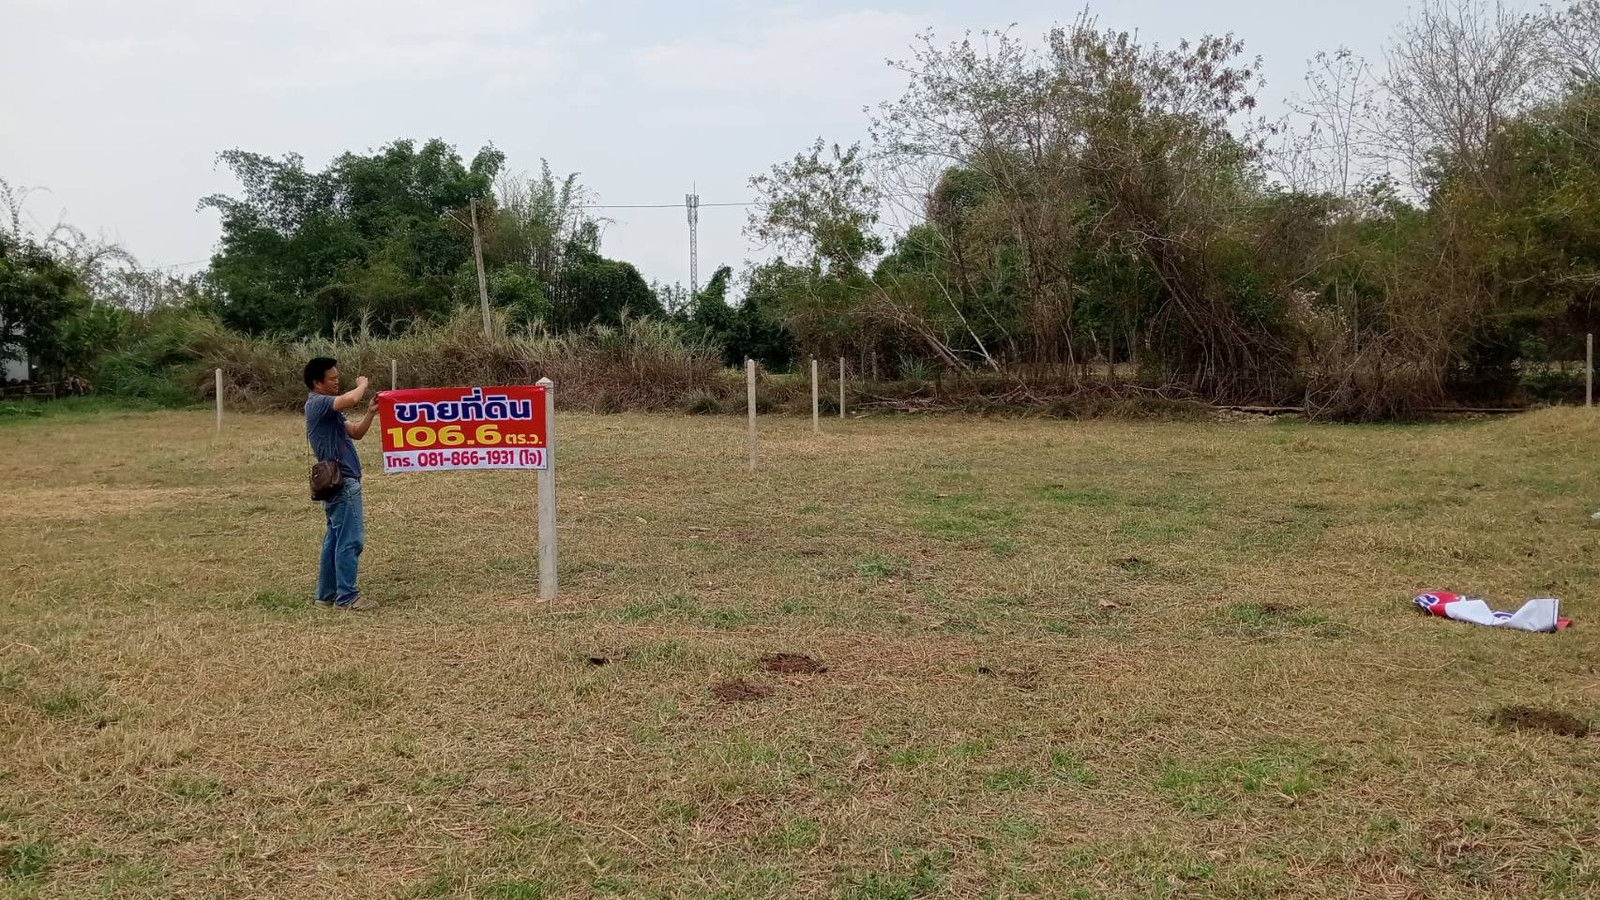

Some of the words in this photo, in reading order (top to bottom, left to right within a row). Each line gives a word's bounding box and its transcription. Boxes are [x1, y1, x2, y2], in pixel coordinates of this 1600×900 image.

[394, 387, 533, 423] ขายที่ดิน
[387, 424, 502, 448] 106.6
[505, 433, 543, 445] ตร.ว.
[386, 455, 414, 468] โทร.
[417, 450, 514, 467] 081-866-1931
